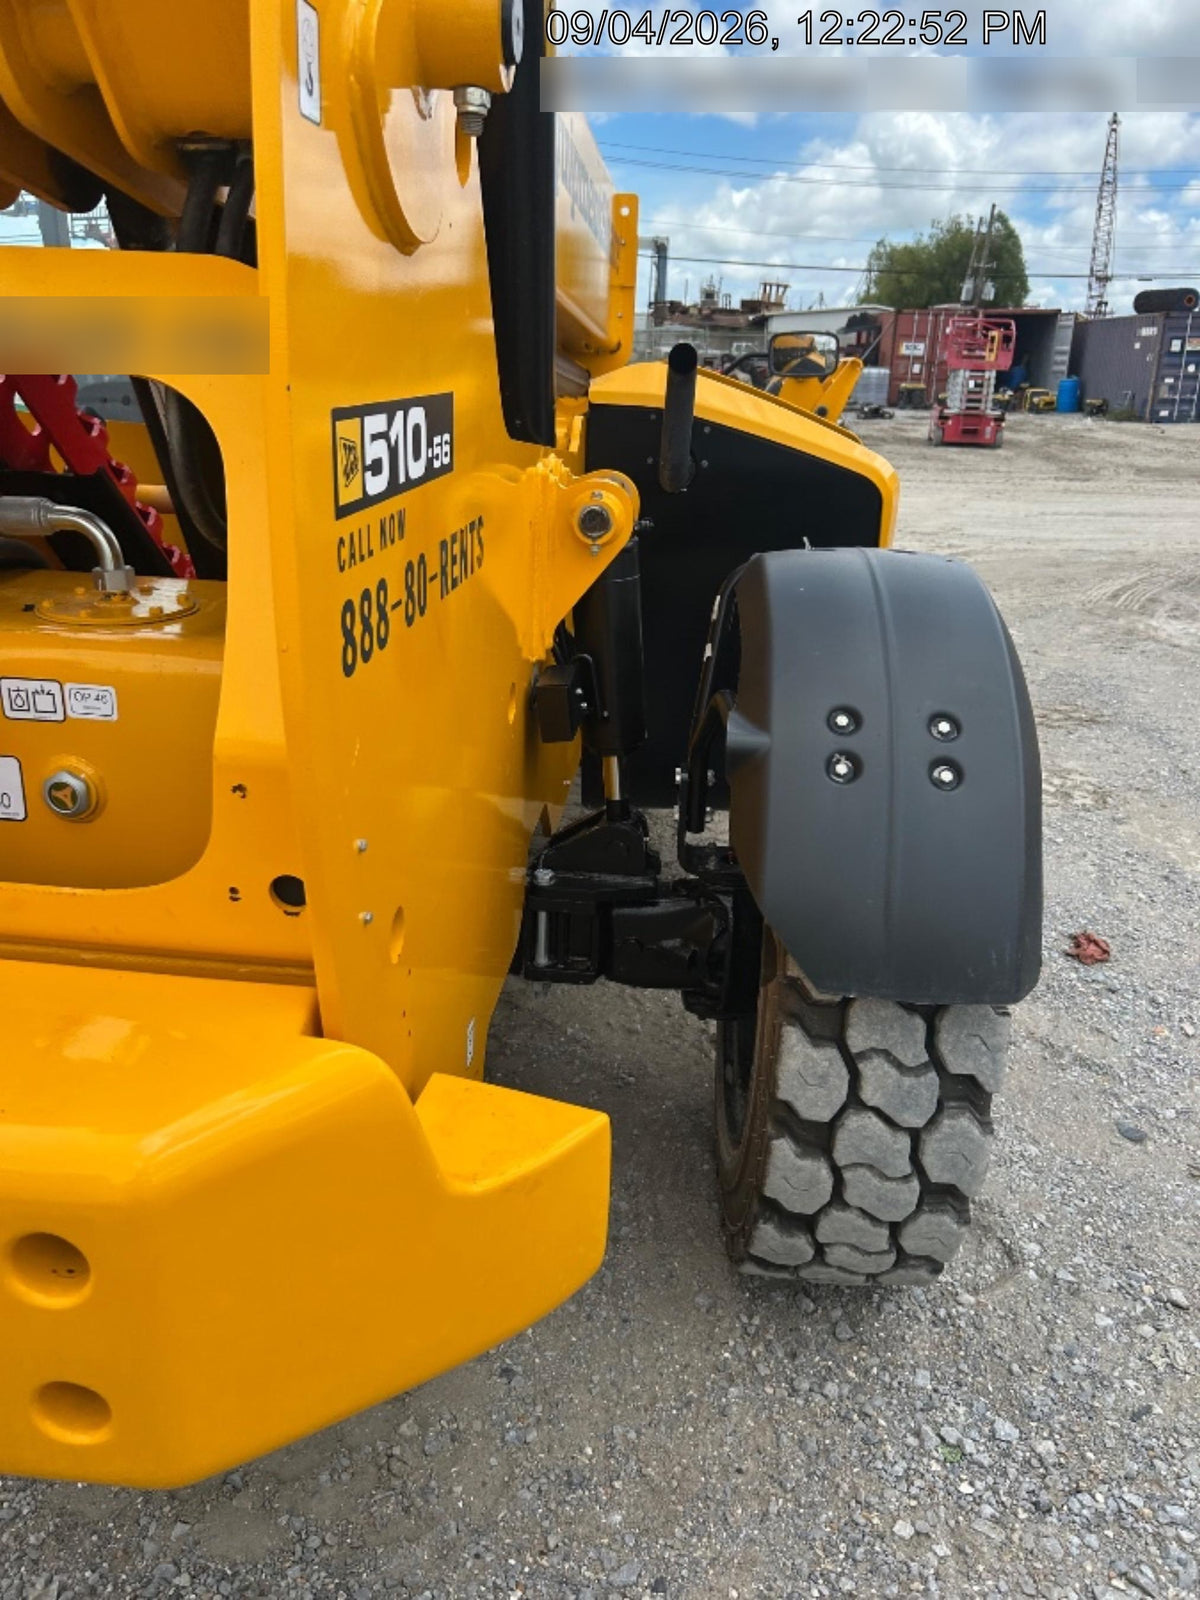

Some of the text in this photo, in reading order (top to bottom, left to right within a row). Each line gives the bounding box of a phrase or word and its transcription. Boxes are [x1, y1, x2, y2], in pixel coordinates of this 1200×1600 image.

[337, 508, 407, 573] CALL NOW
[341, 515, 485, 678] 888-80-RENTS
